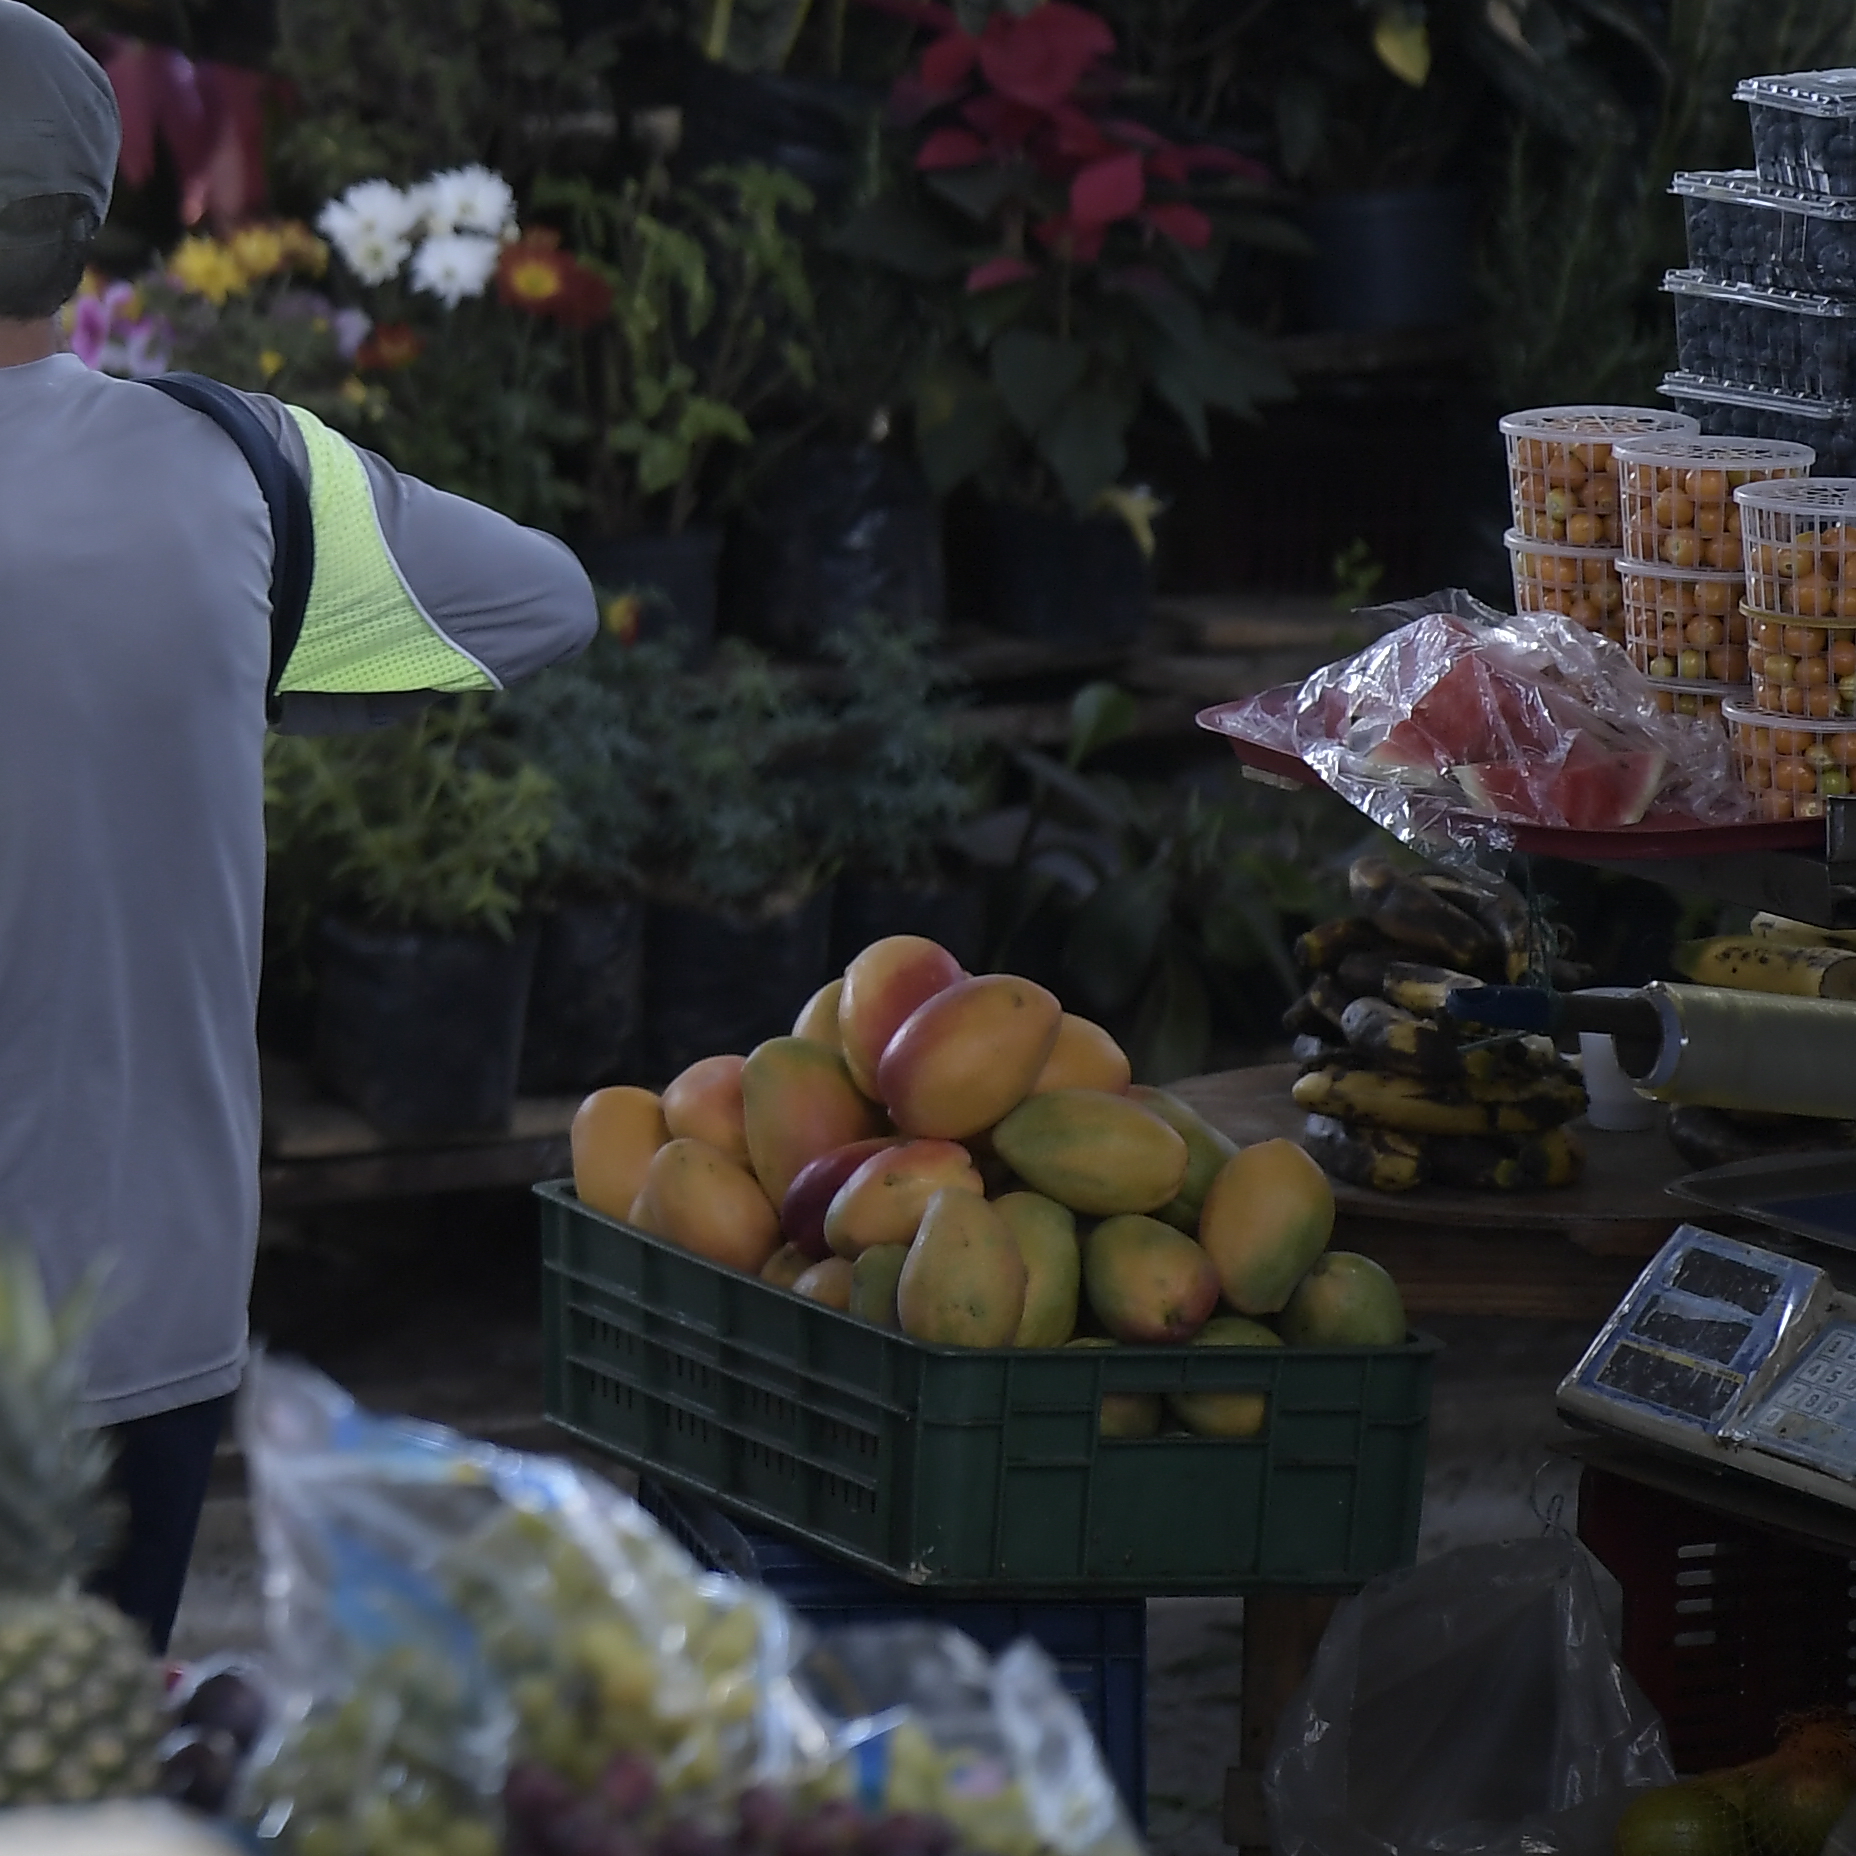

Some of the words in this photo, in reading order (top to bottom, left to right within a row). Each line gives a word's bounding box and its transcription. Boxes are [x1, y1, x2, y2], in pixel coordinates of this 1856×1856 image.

[1808, 1364, 1821, 1377] 4
[1826, 1370, 1842, 1383] 5
[1787, 1388, 1801, 1399] 7
[1805, 1394, 1820, 1409] 8
[1824, 1401, 1840, 1414] 9
